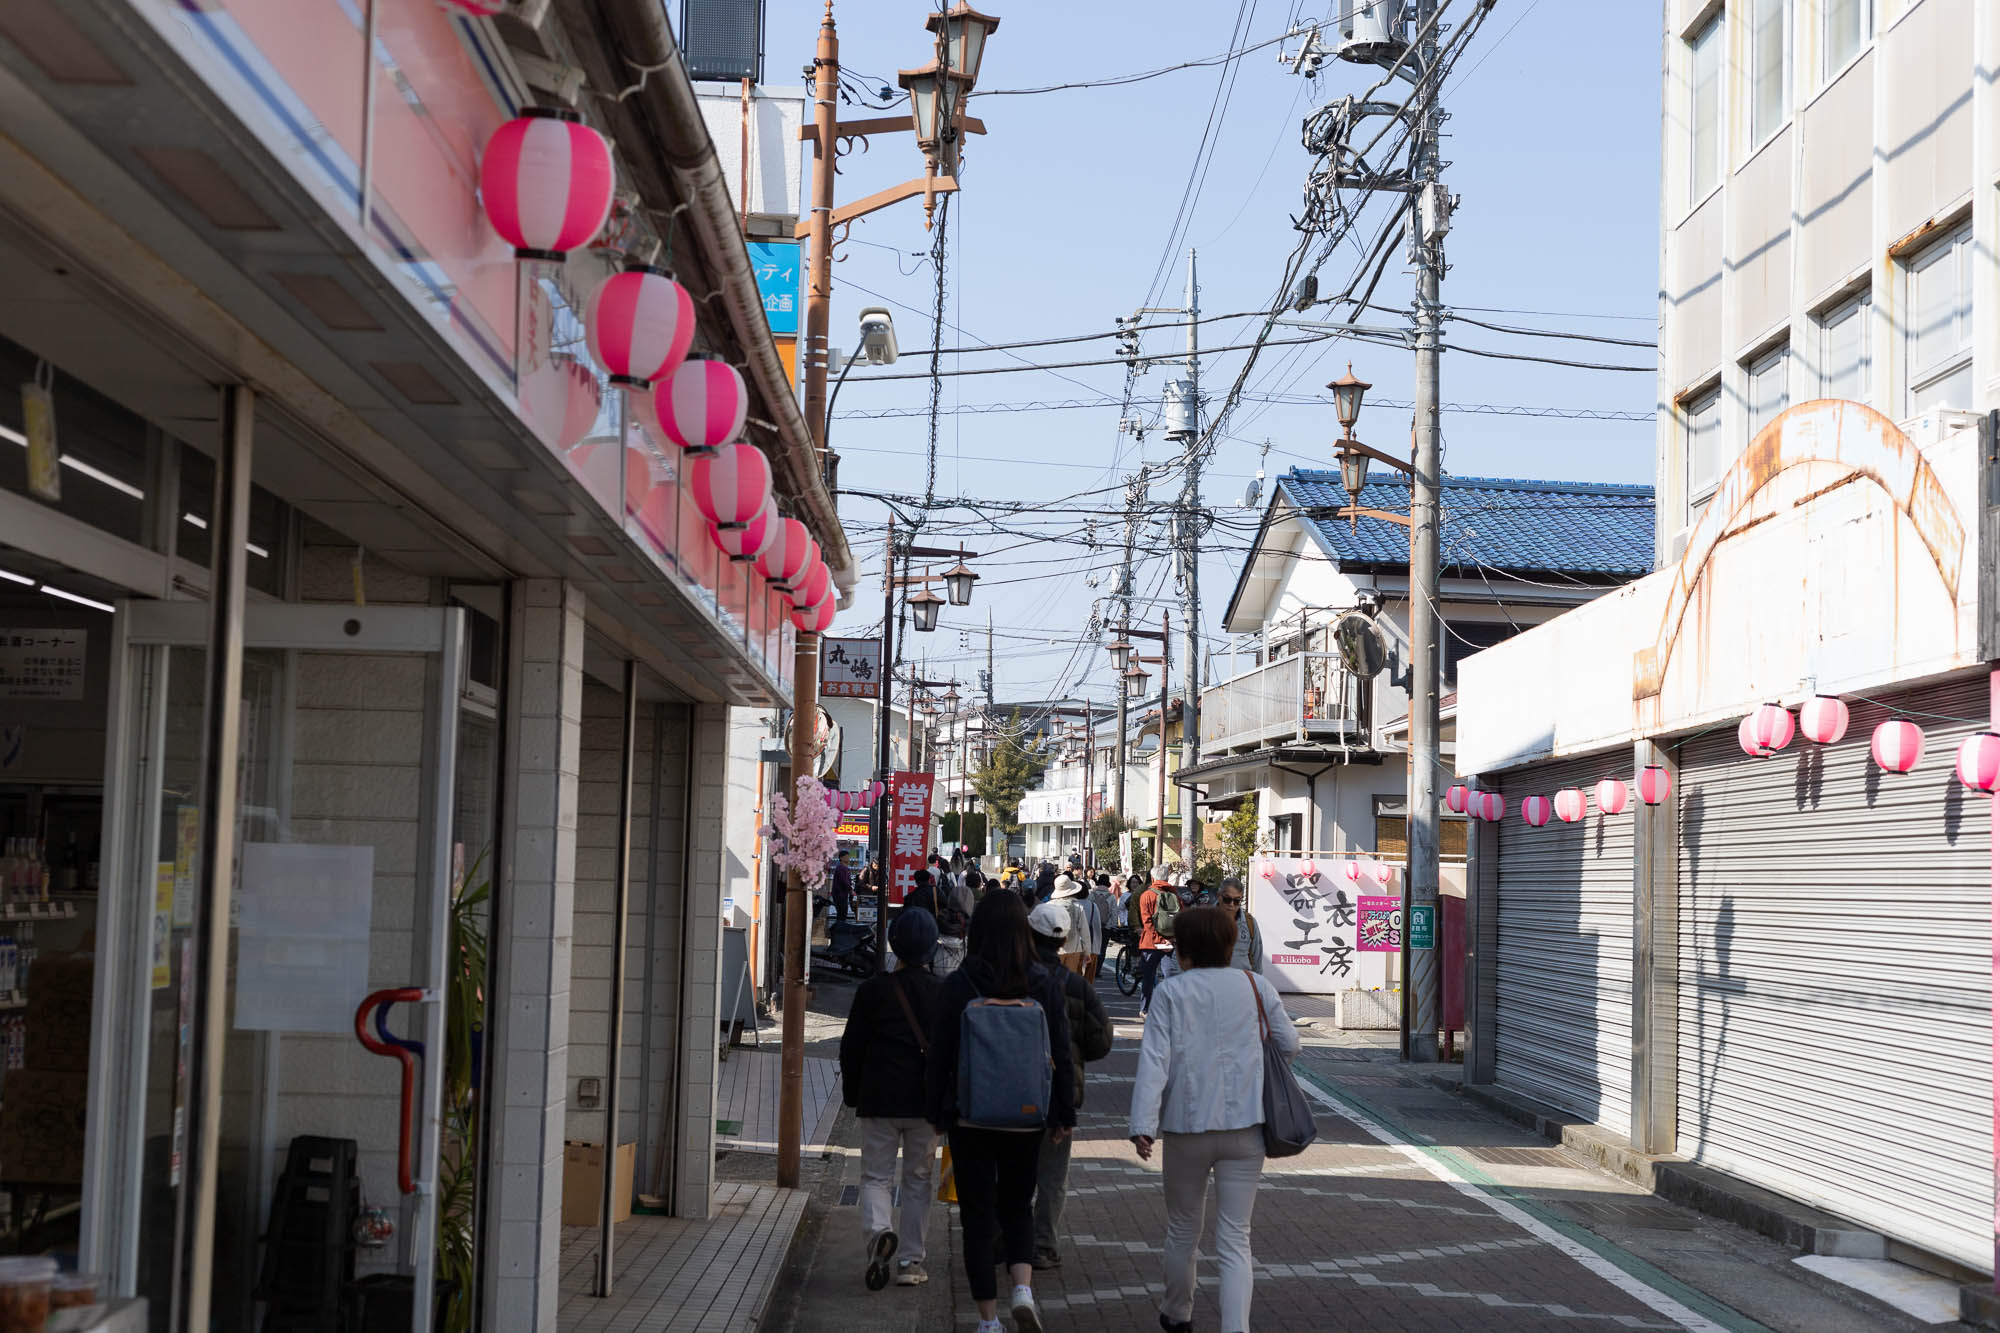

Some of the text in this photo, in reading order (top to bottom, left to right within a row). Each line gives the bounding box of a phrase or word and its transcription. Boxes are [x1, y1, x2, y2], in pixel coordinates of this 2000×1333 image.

[755, 264, 792, 282] ティ
[761, 294, 792, 312] 企画
[829, 644, 874, 680] 丸嶋
[826, 682, 875, 695] お食事処
[895, 782, 929, 896] 営業中
[1280, 955, 1312, 964] kiikobo
